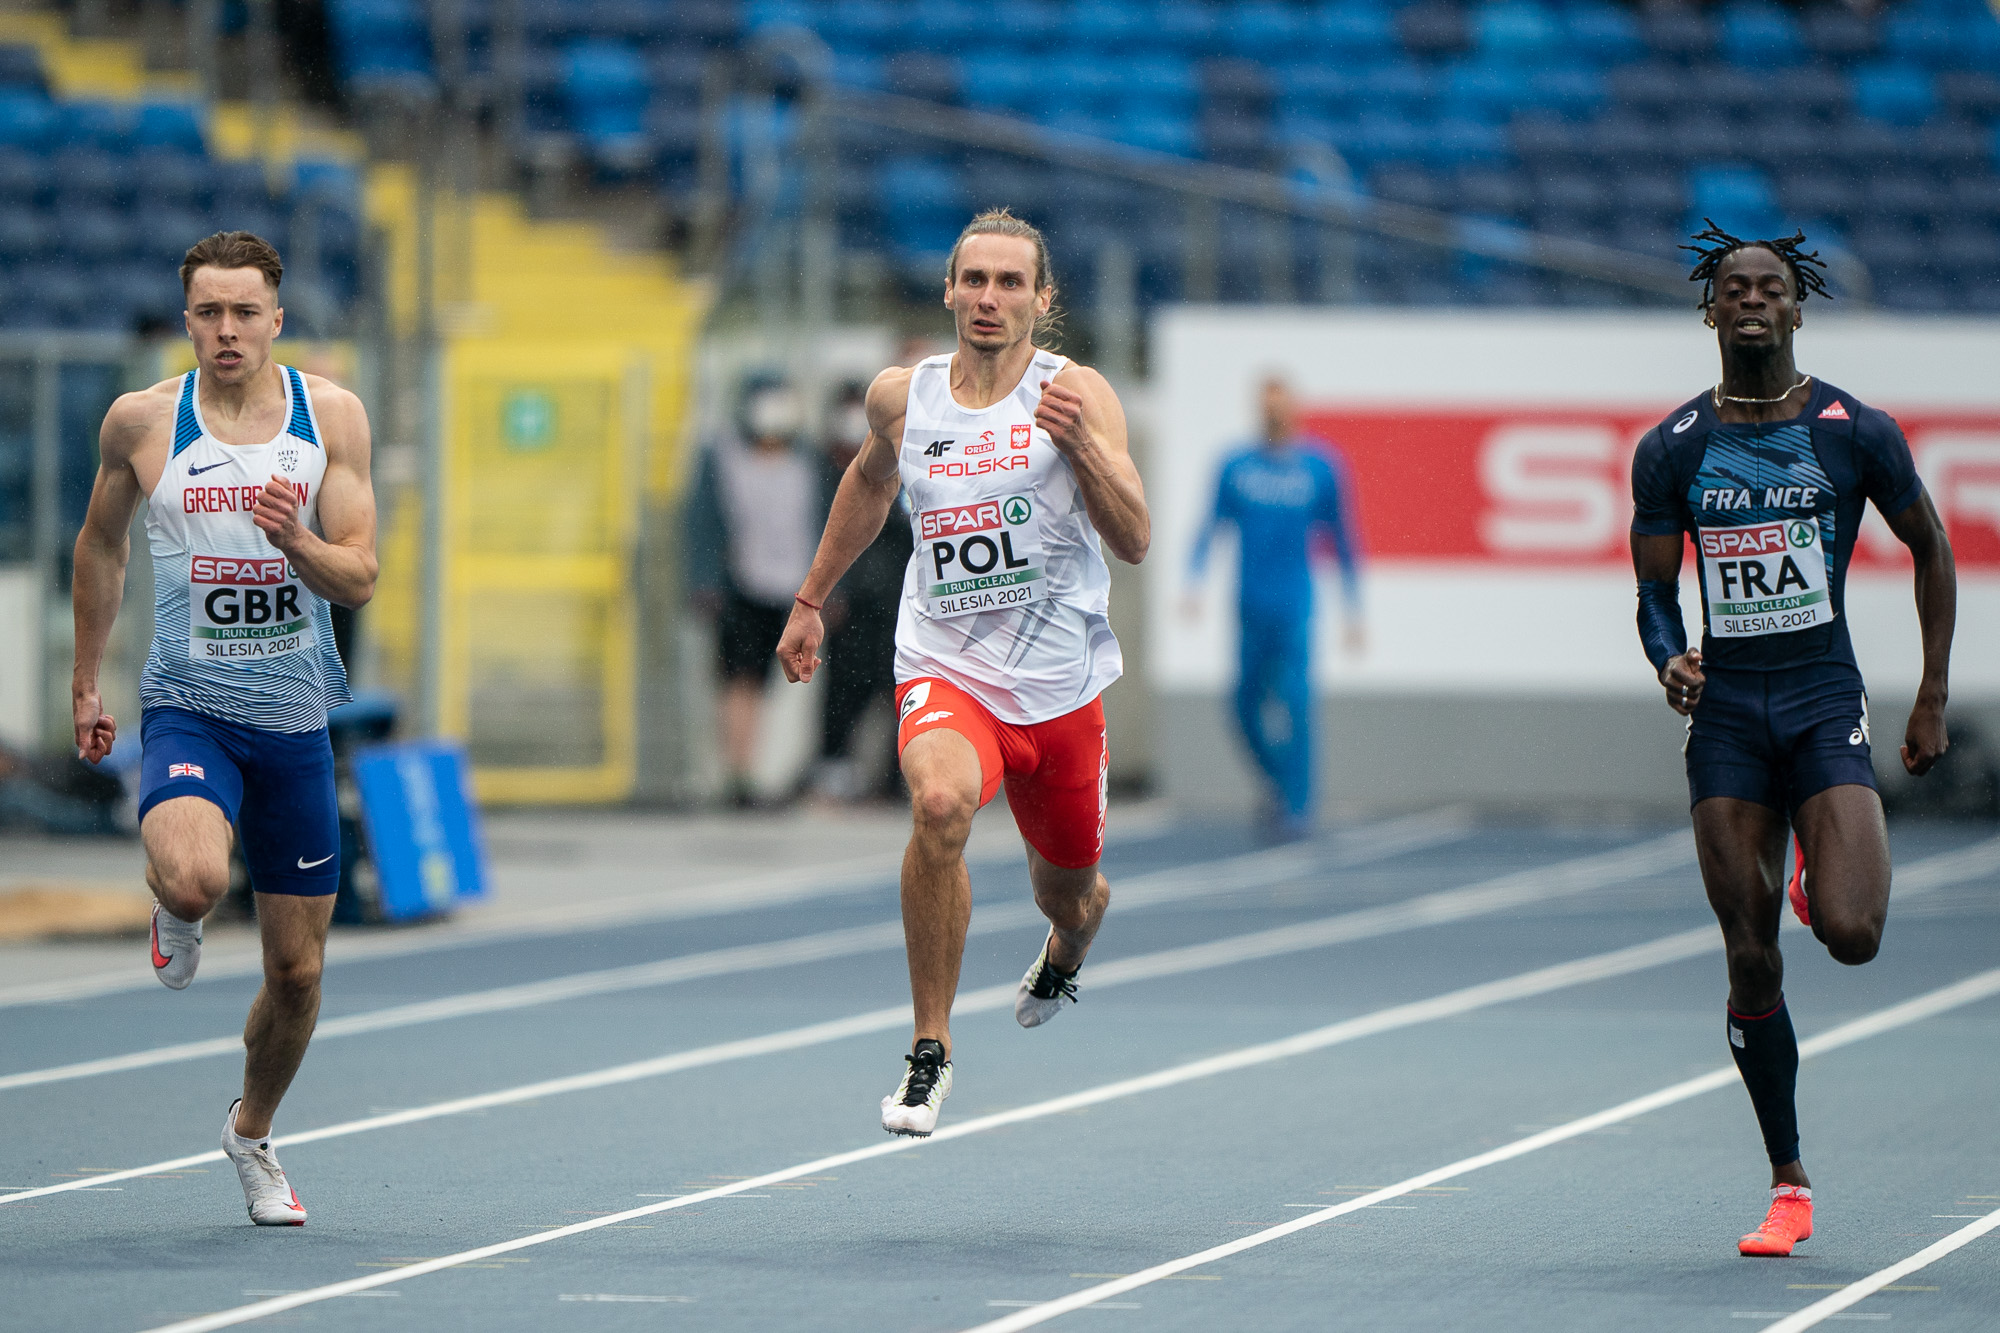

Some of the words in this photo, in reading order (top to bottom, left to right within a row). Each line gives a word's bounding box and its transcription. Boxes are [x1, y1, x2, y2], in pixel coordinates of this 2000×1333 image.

[1822, 409, 1845, 417] MAIF
[924, 440, 955, 457] 4F
[966, 443, 994, 454] ORLEN
[929, 455, 1029, 479] POLSKA
[184, 486, 239, 513] GREAT
[923, 505, 999, 536] SPAR
[1703, 529, 1784, 554] SPAR
[932, 531, 1029, 581] POL
[194, 560, 283, 582] SPAR
[1718, 554, 1810, 600] FRA
[945, 584, 949, 594] I
[951, 581, 976, 594] RUN
[205, 584, 302, 625] GBR
[940, 593, 995, 614] SILESIA
[997, 586, 1032, 605] 2021
[1730, 604, 1734, 614] I
[1735, 603, 1759, 614] RUN
[222, 628, 248, 638] RUN
[1724, 616, 1778, 633] SILESIA
[1781, 609, 1817, 628] 2021
[206, 643, 264, 656] SILESIA
[268, 636, 300, 654] 2021
